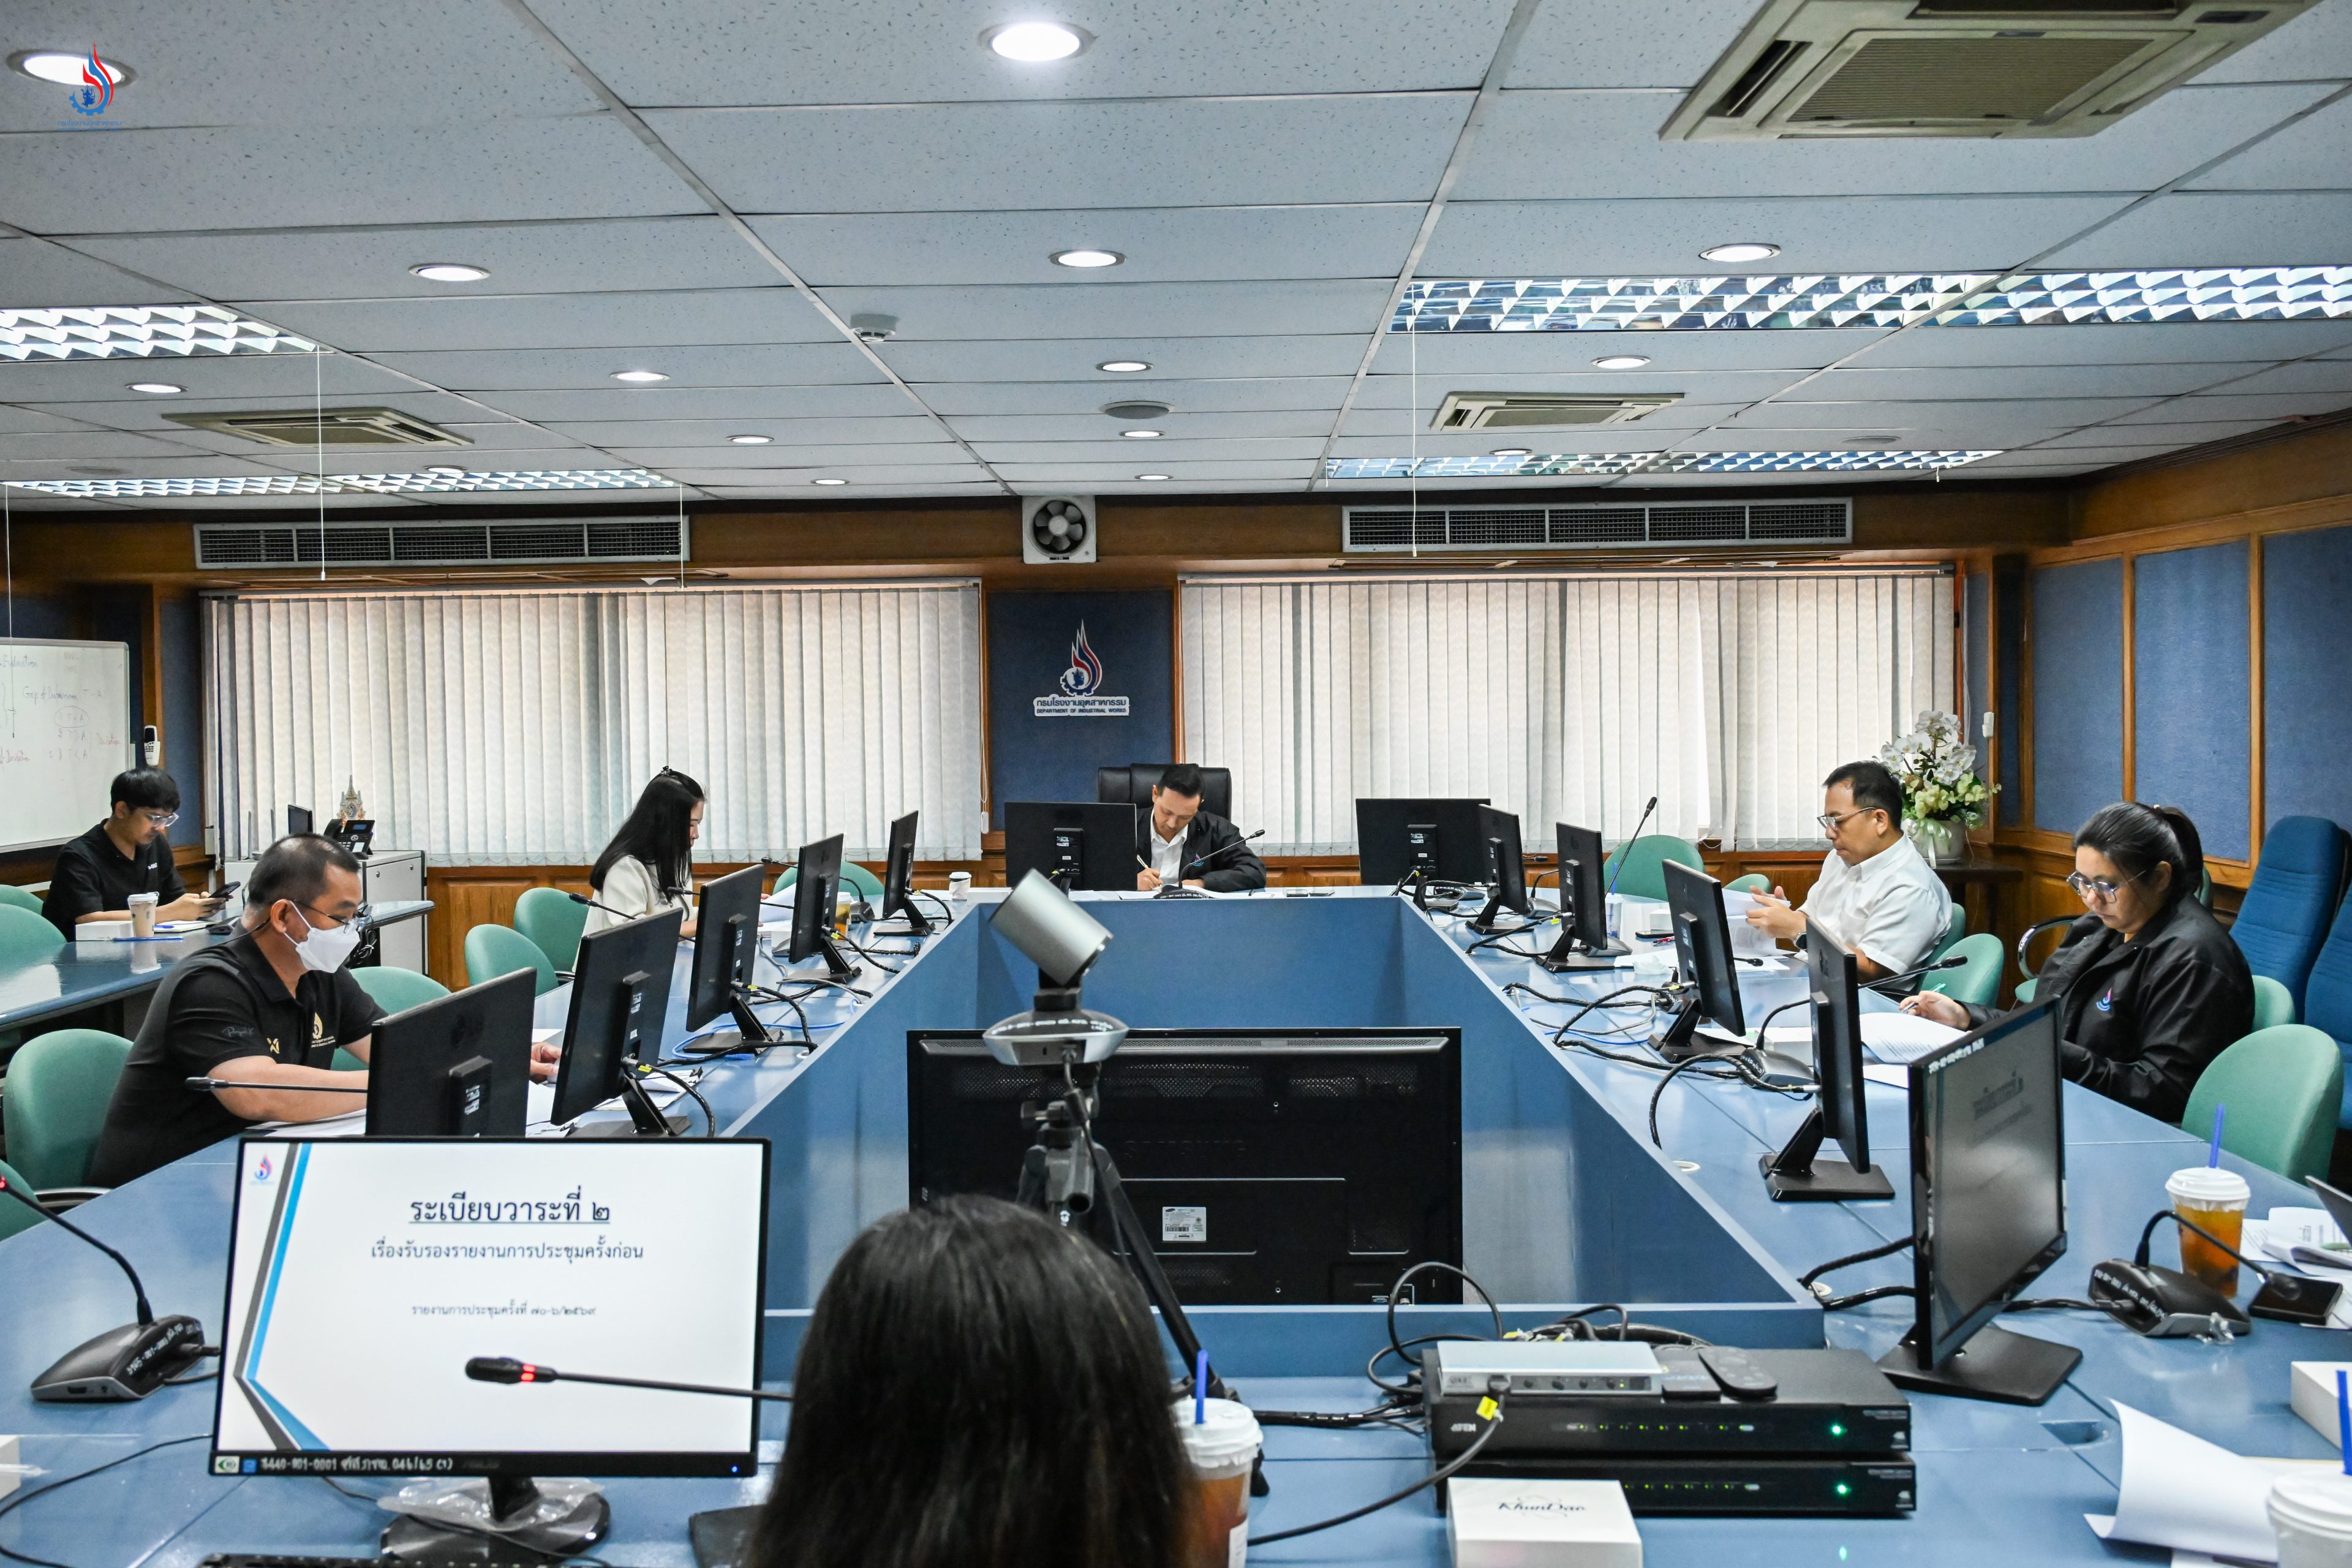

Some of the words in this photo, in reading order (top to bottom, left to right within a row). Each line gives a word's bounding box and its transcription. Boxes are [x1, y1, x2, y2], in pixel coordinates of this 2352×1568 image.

[1036, 697, 1126, 707] กรมโรงงานอุตสาหกรรม
[411, 1185, 581, 1221] ระเบียบวาระที่
[592, 1202, 609, 1221] ๒
[371, 1235, 644, 1264] เรื่องรับรองรายงานการประชุมครั้งก่อน
[412, 1298, 527, 1319] รายงานการประชุมครั้งที่
